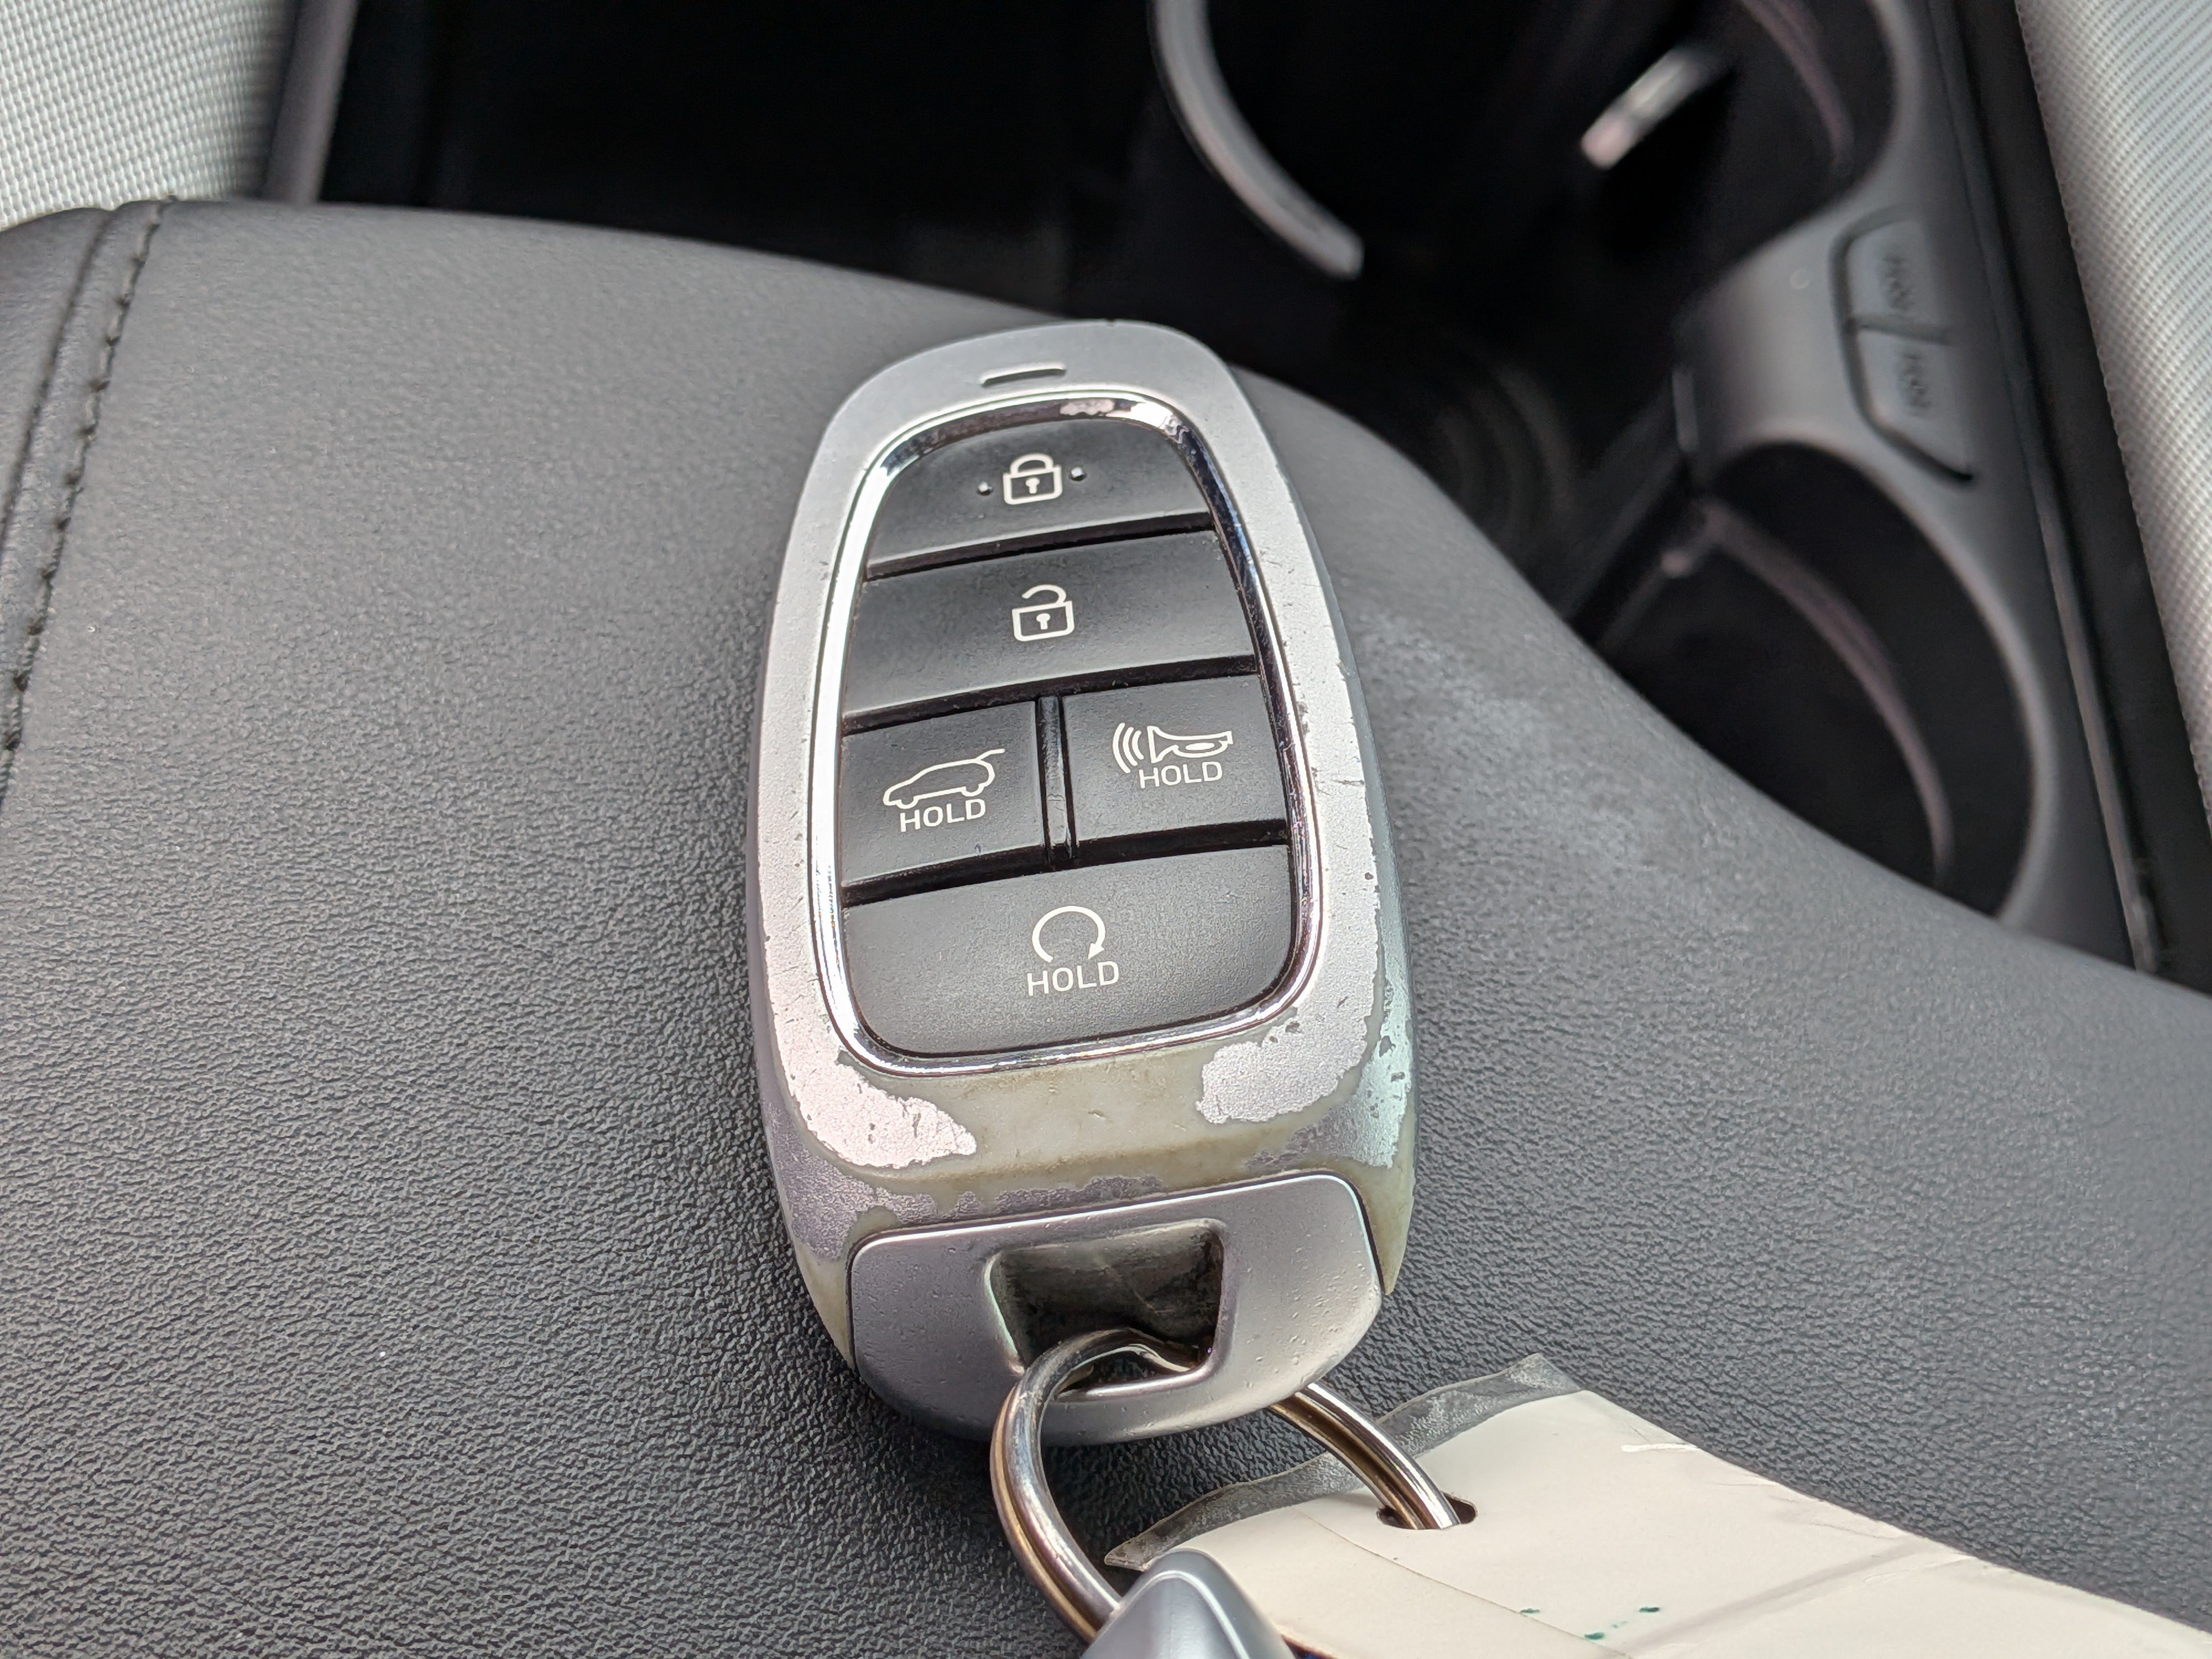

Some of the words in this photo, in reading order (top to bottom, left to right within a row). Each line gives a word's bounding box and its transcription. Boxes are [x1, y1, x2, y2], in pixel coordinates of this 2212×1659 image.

[1138, 761, 1223, 789] HOLD
[900, 798, 987, 832] HOLD
[1026, 961, 1120, 997] HOLD
